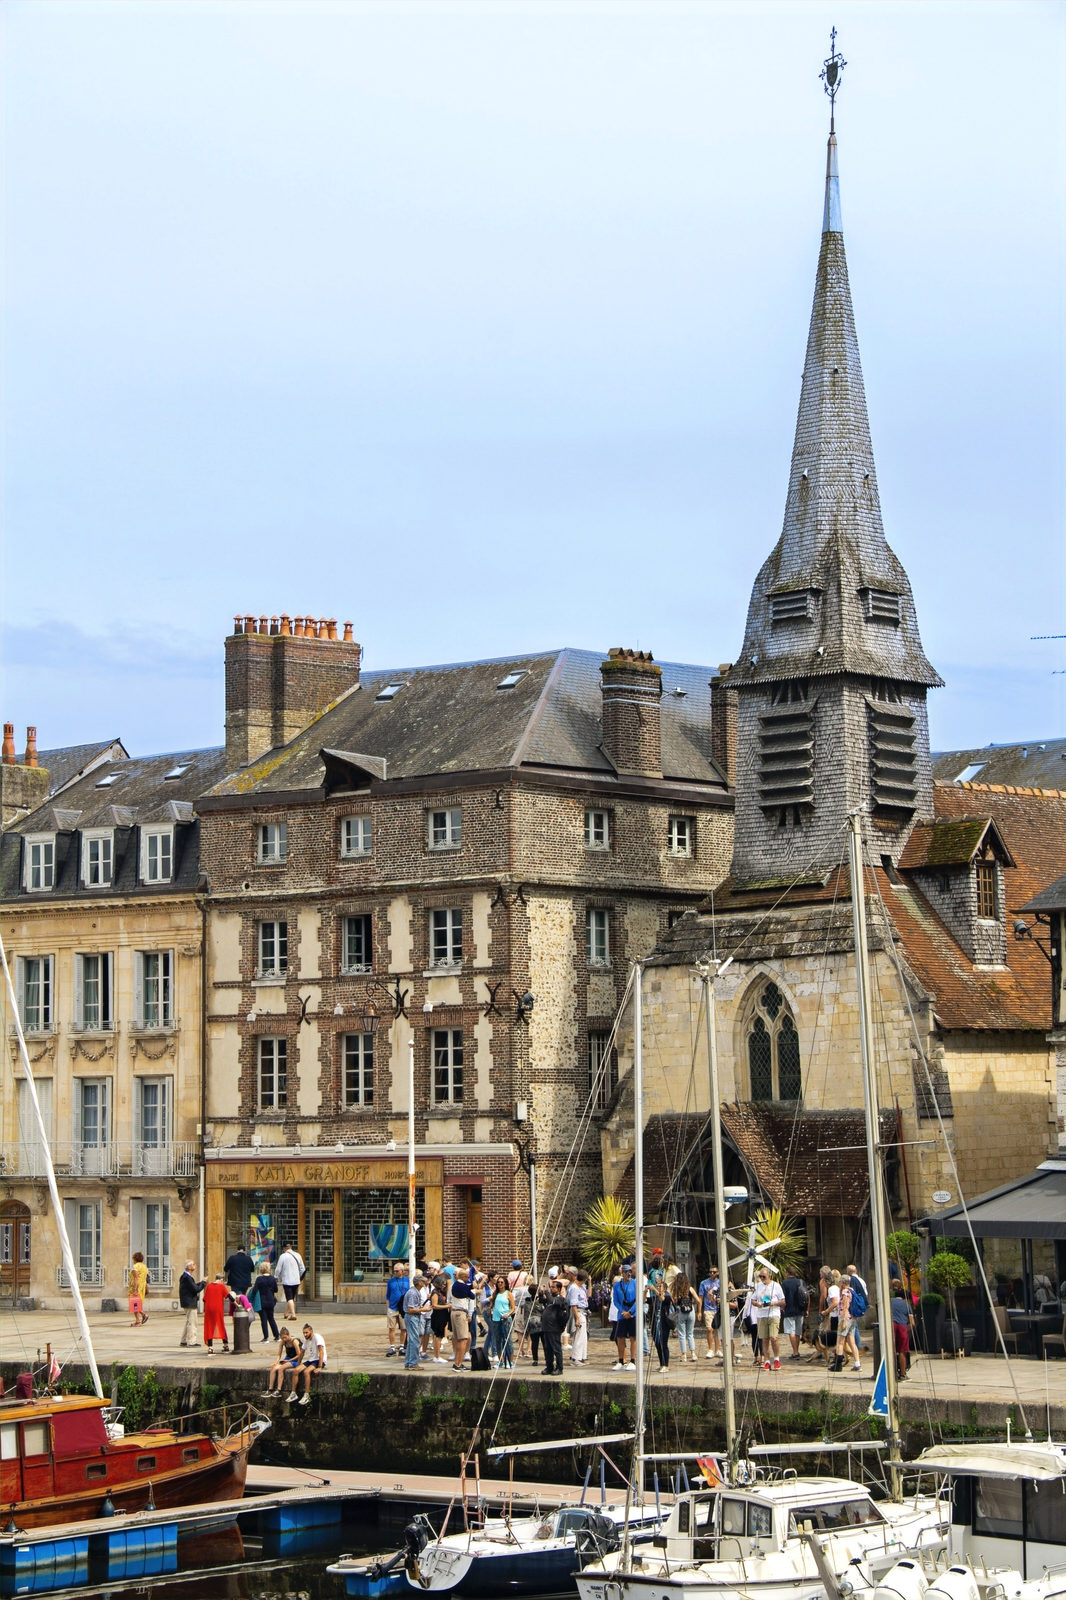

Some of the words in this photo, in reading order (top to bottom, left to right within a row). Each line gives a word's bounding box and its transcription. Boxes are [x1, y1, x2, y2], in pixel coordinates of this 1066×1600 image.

[254, 1165, 296, 1183] KATIA
[304, 1164, 370, 1181] GRANOFF
[384, 1170, 425, 1180] HONFLUR
